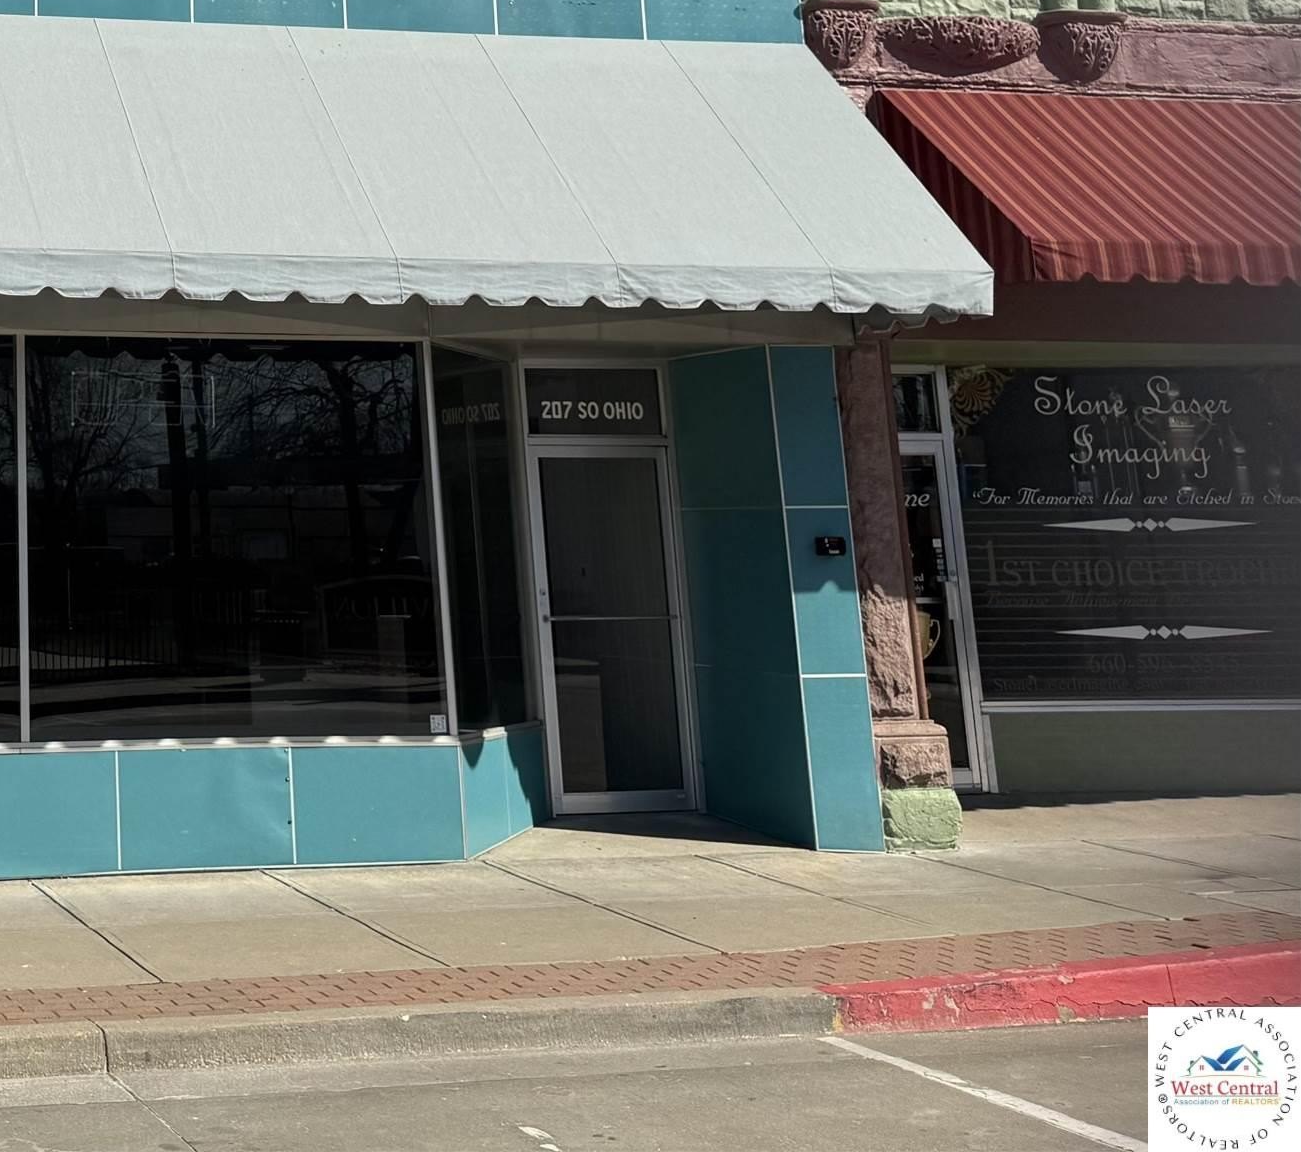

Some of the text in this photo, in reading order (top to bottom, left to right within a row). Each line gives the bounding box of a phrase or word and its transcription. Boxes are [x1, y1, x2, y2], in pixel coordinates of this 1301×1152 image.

[1034, 375, 1232, 416] Stone Laser
[541, 400, 644, 420] 207 SO OHIO
[1069, 424, 1211, 480] Imaging
[1016, 487, 1094, 505] Memories
[1102, 487, 1134, 505] that
[1143, 493, 1168, 505] are
[1176, 487, 1233, 505] Etched
[1240, 493, 1255, 505] in
[1051, 559, 1170, 587] CHOICE
